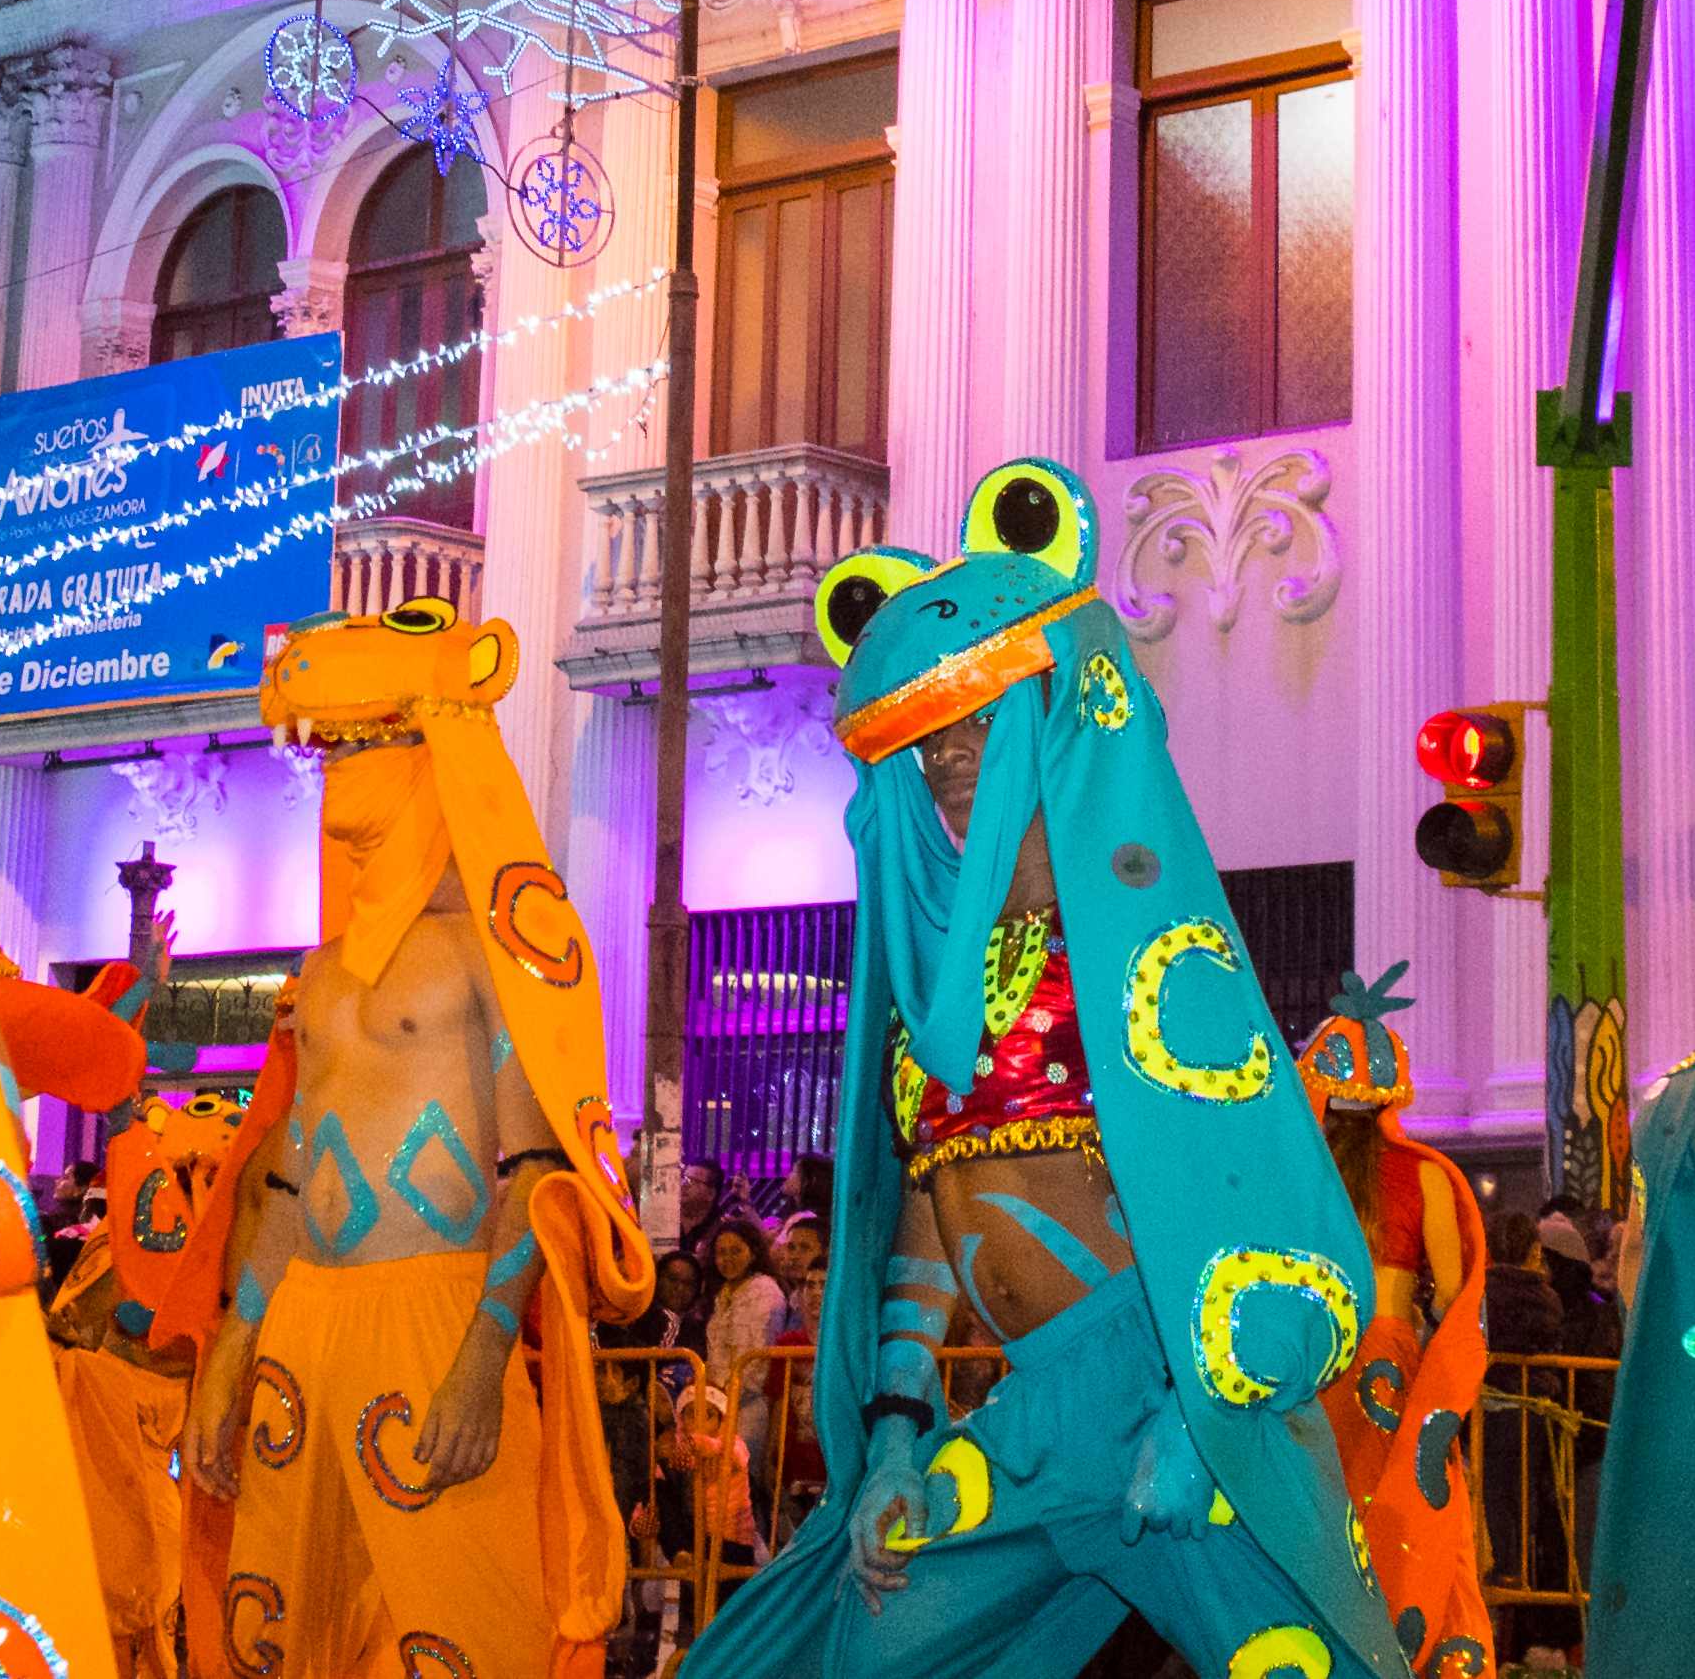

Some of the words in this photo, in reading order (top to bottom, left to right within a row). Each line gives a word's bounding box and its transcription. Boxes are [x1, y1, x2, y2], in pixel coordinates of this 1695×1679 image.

[240, 376, 306, 406] INVITA
[33, 417, 107, 456] sueños
[95, 497, 147, 523] ZAMORA
[61, 561, 163, 609] GRATUITA
[19, 648, 171, 693] Diciembre
